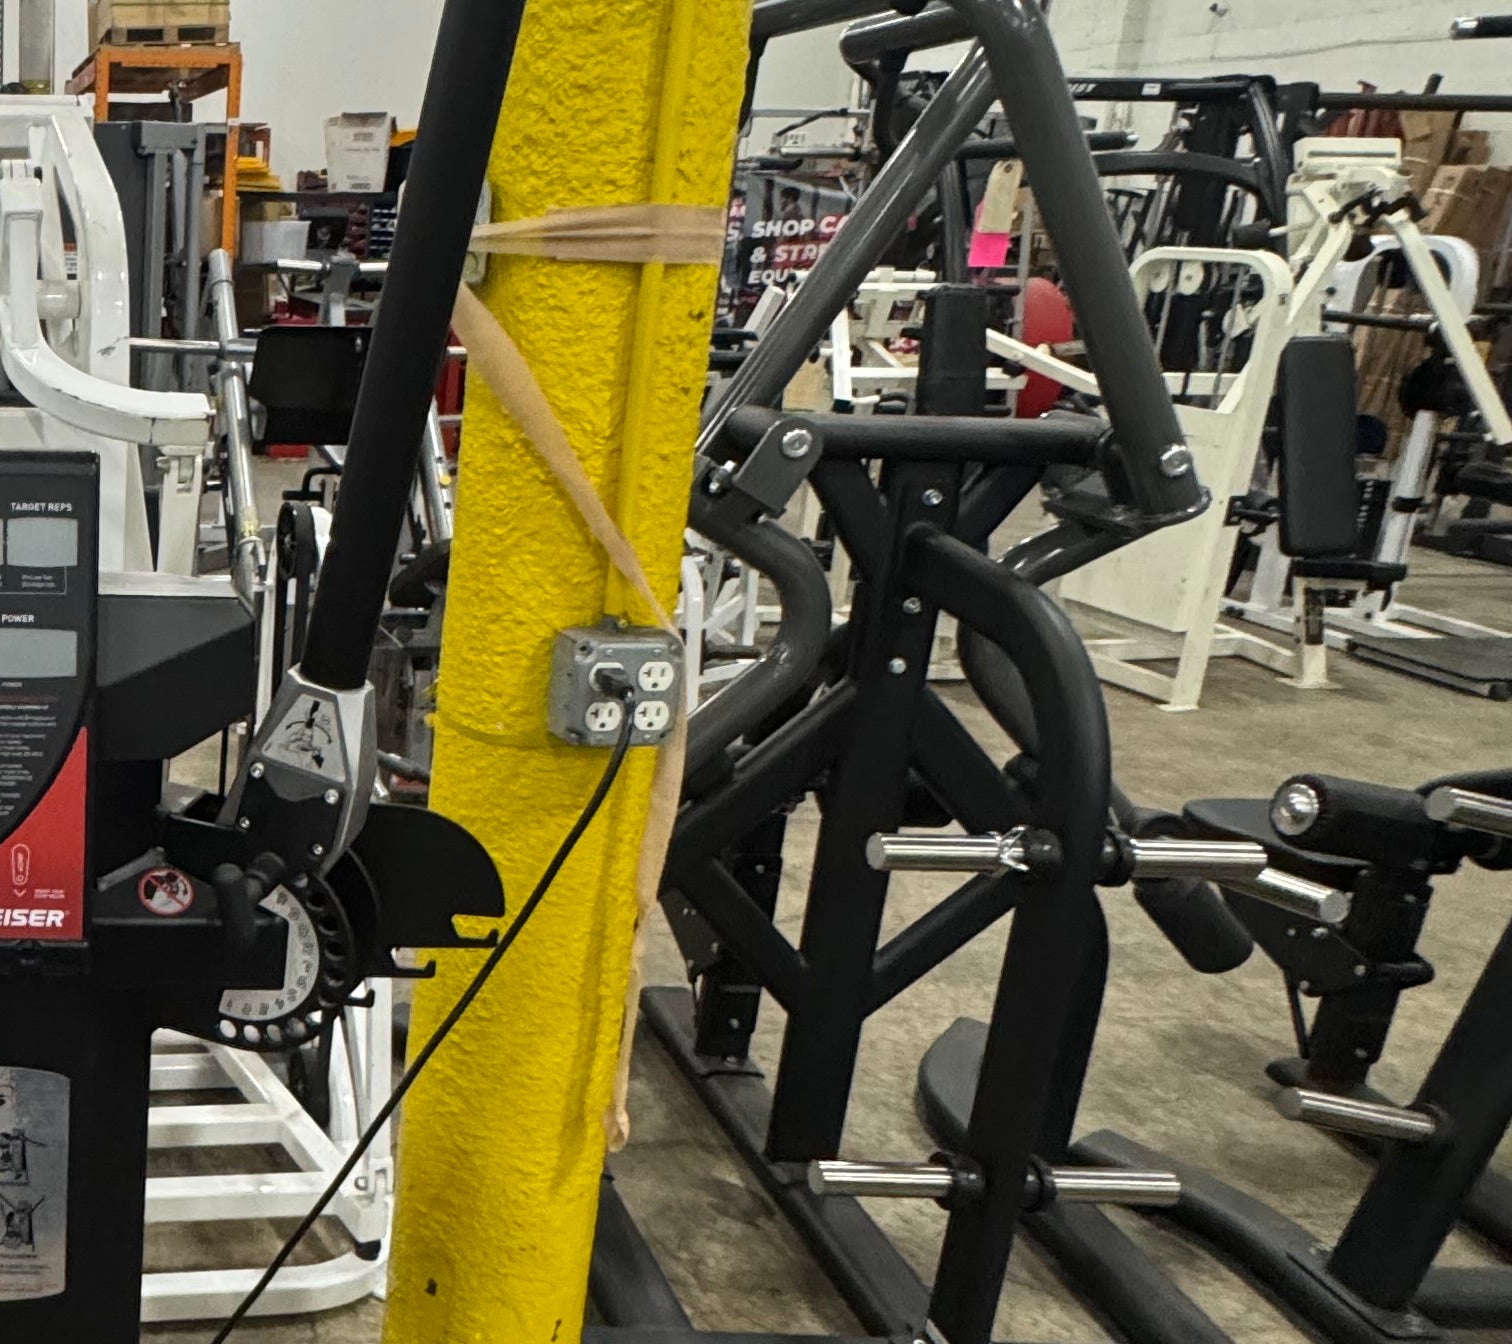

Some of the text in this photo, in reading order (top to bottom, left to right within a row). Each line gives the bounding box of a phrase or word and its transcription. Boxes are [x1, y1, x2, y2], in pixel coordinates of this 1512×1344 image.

[752, 219, 815, 238] SHOP
[750, 246, 766, 263] &
[10, 502, 73, 512] TARGET REPS
[1, 614, 35, 623] POWER
